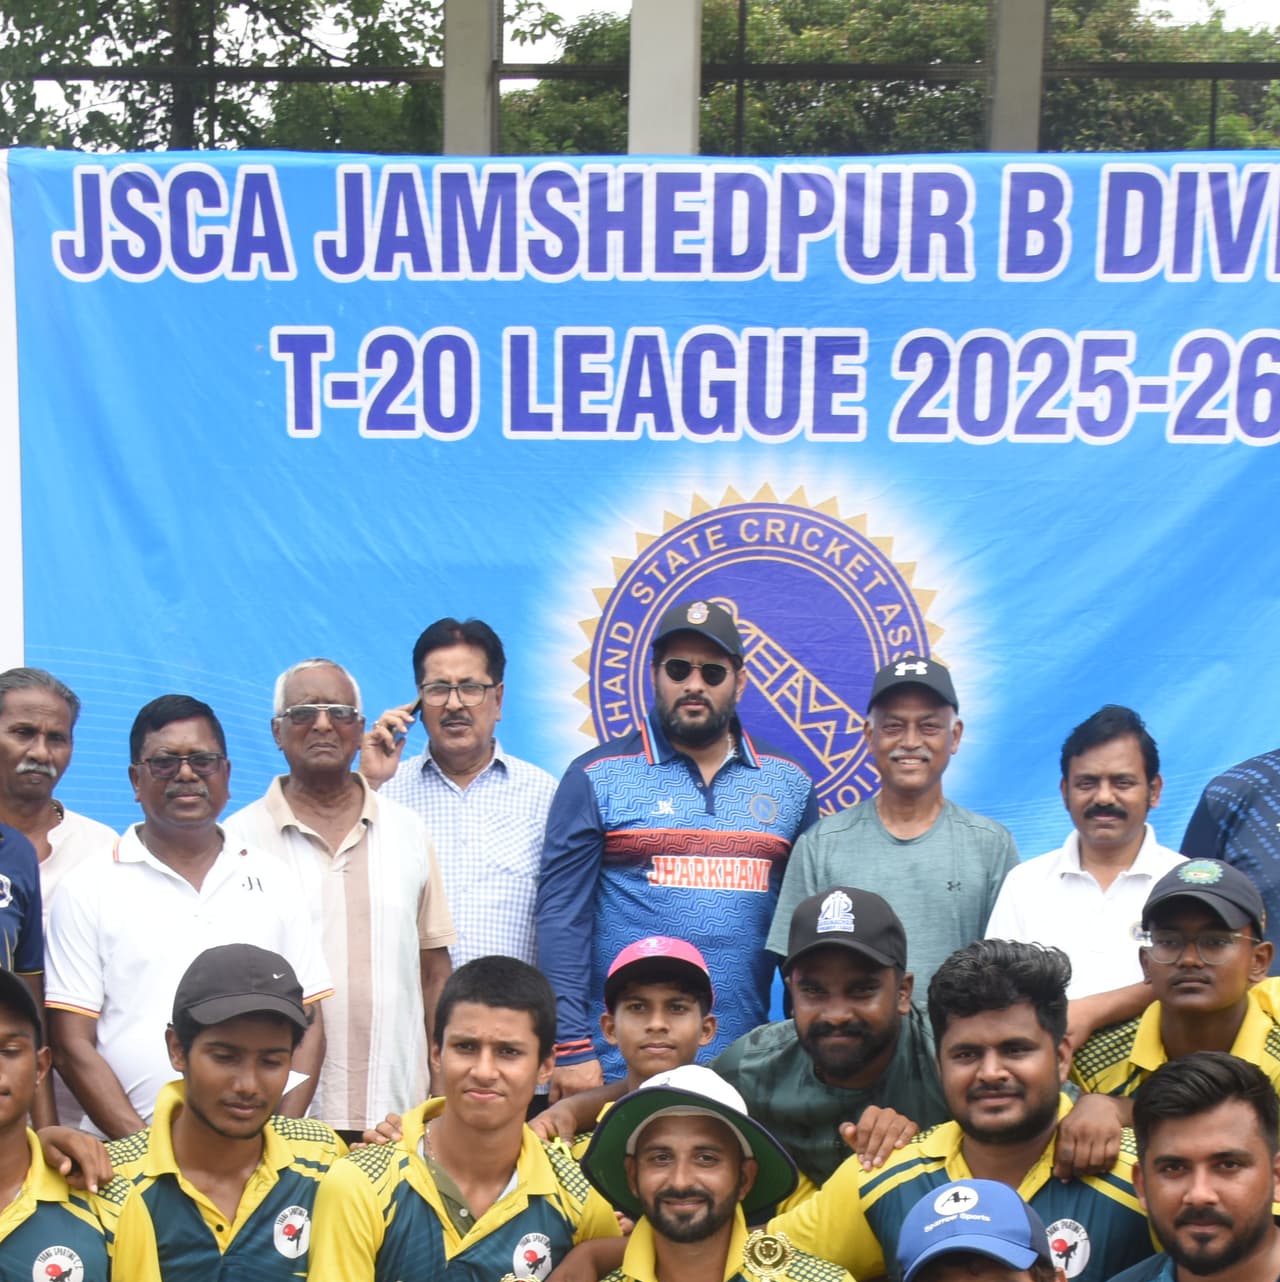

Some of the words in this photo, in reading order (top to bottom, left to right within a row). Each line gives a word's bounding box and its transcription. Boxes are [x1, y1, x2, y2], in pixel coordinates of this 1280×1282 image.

[57, 169, 291, 276] JSCA
[319, 169, 970, 277] JAMSHEDPUR
[1005, 170, 1067, 275] B
[274, 332, 475, 434] T-20
[508, 332, 863, 436] LEAGUE
[631, 525, 728, 604] STATE
[739, 517, 888, 594] CRICKET
